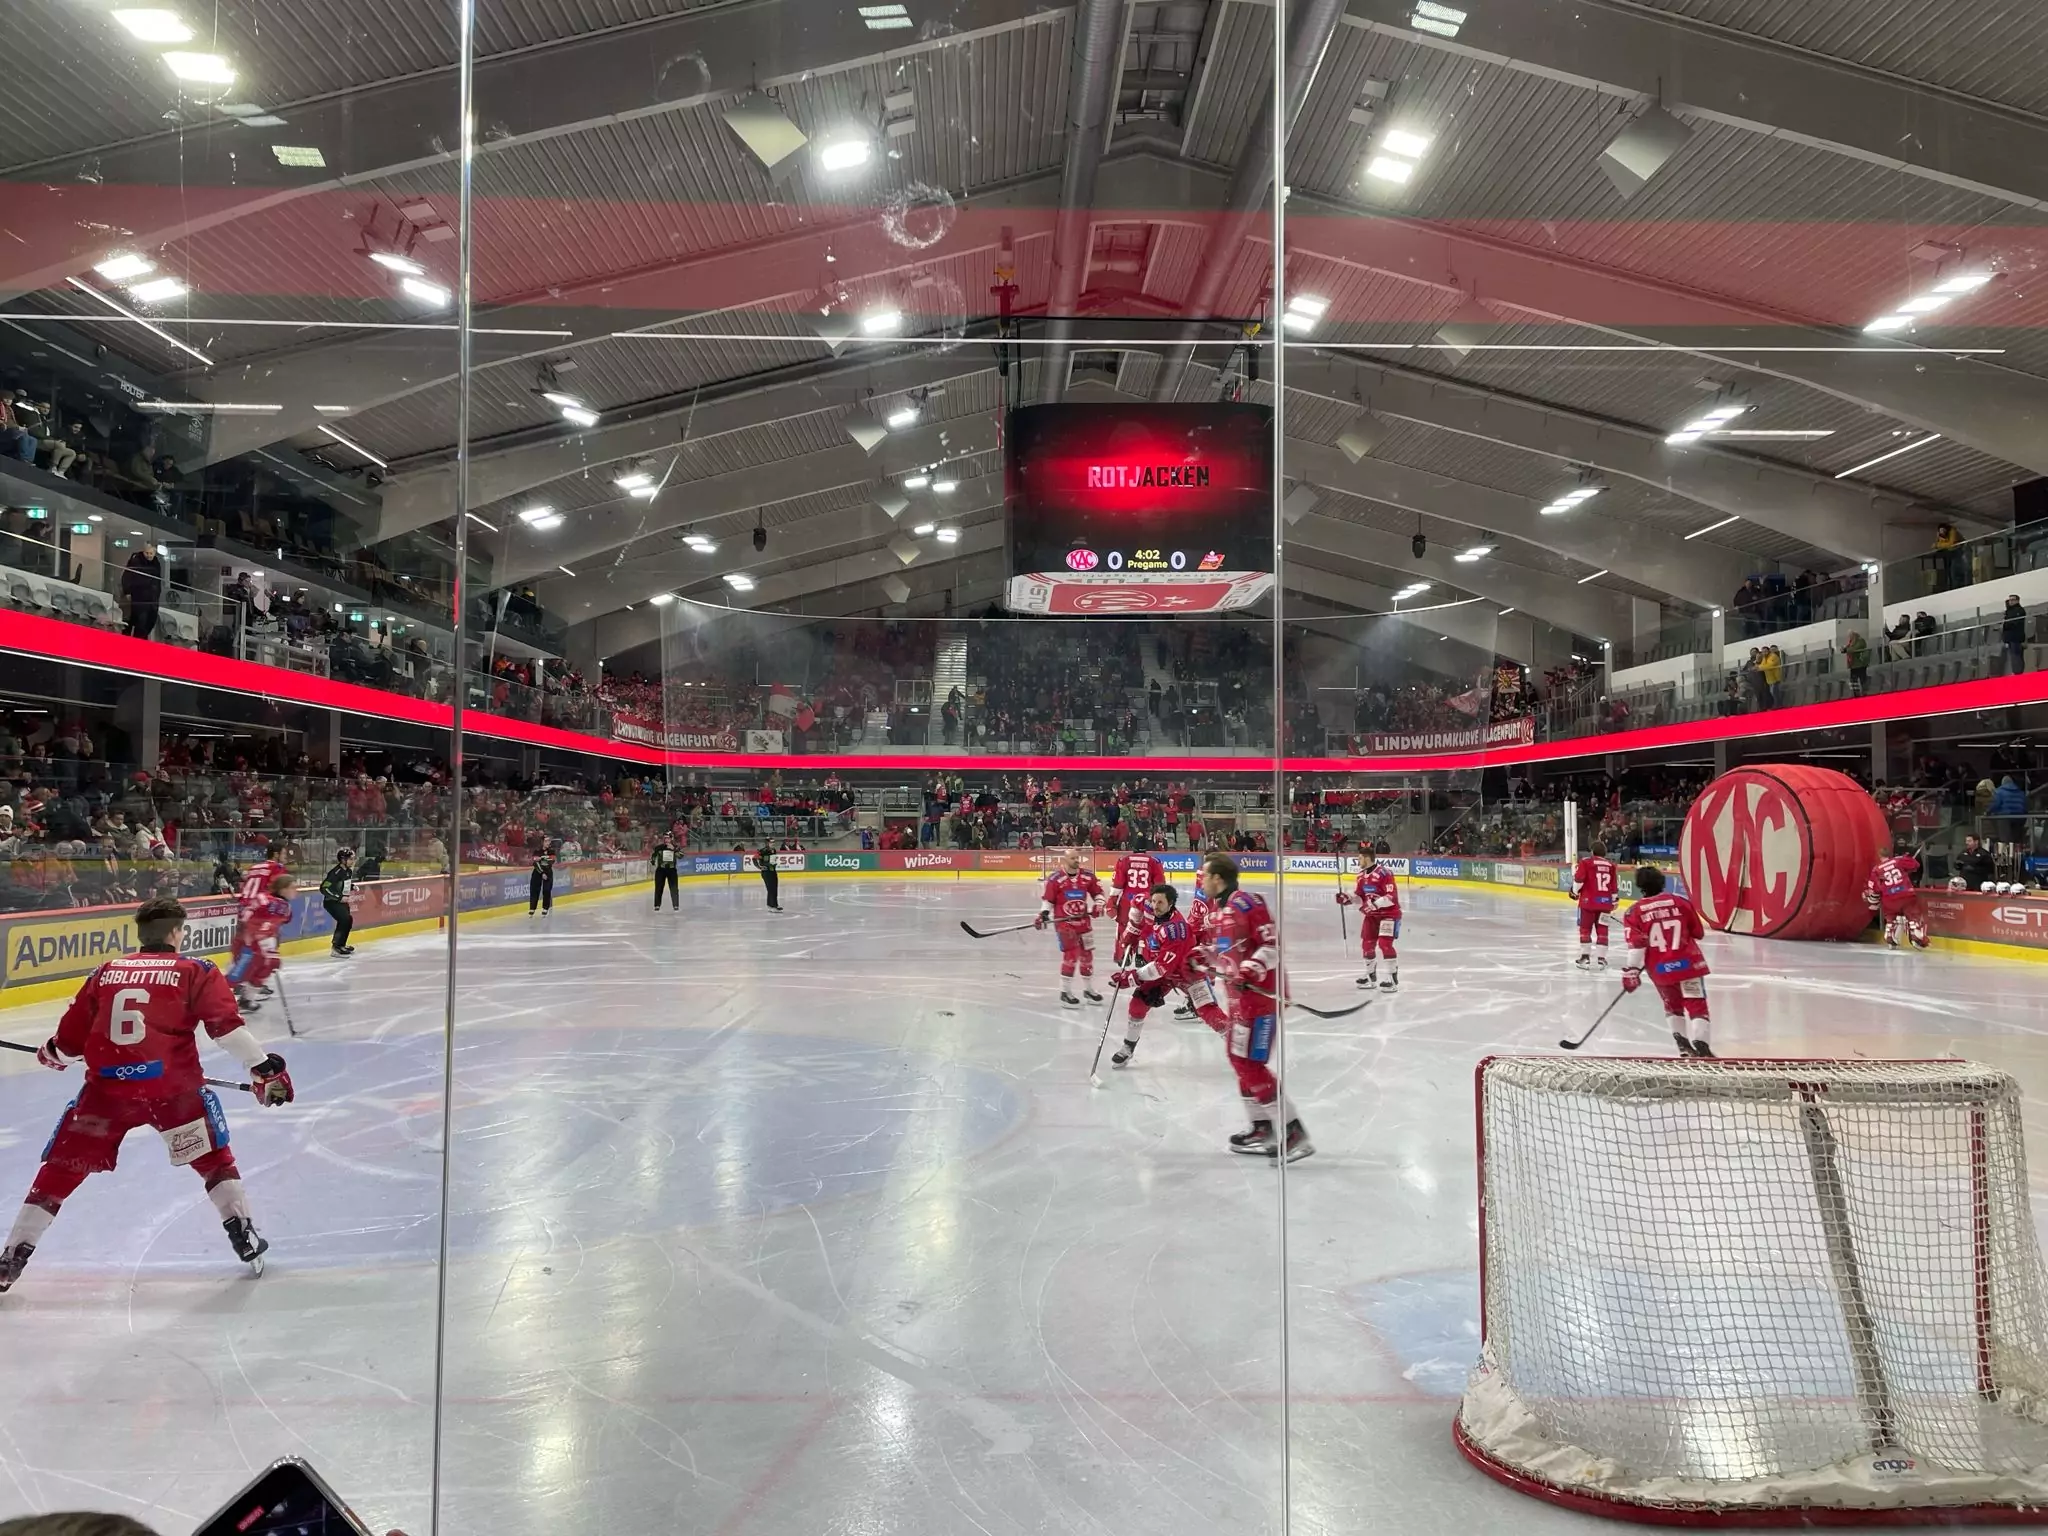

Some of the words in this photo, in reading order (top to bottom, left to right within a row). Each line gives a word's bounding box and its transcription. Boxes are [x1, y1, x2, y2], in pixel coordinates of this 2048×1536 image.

[120, 381, 145, 400] HOLTER
[1088, 466, 1209, 488] ROTJACKEN
[1107, 551, 1123, 570] 0
[1135, 549, 1161, 560] 4:02
[1171, 551, 1186, 570] 0
[1127, 560, 1168, 570] Pregame
[1375, 728, 1479, 751] LINDWURMKURVE
[1483, 721, 1521, 743] KLAGENFURT
[695, 862, 729, 873] SPARKASSE
[824, 854, 860, 870] kelag
[904, 853, 952, 868] win2day
[1291, 859, 1339, 869] RANACHER
[1127, 868, 1149, 889] 33
[1415, 865, 1452, 877] SPARKASSE
[1883, 868, 1903, 887] 32
[1595, 872, 1611, 892] 12
[1649, 919, 1682, 953] 47
[13, 924, 136, 971] ADMIRAL
[1163, 951, 1177, 965] 17
[99, 969, 181, 988] SABLATTNIG
[110, 988, 151, 1046] 6
[1872, 1459, 1908, 1474] engo
